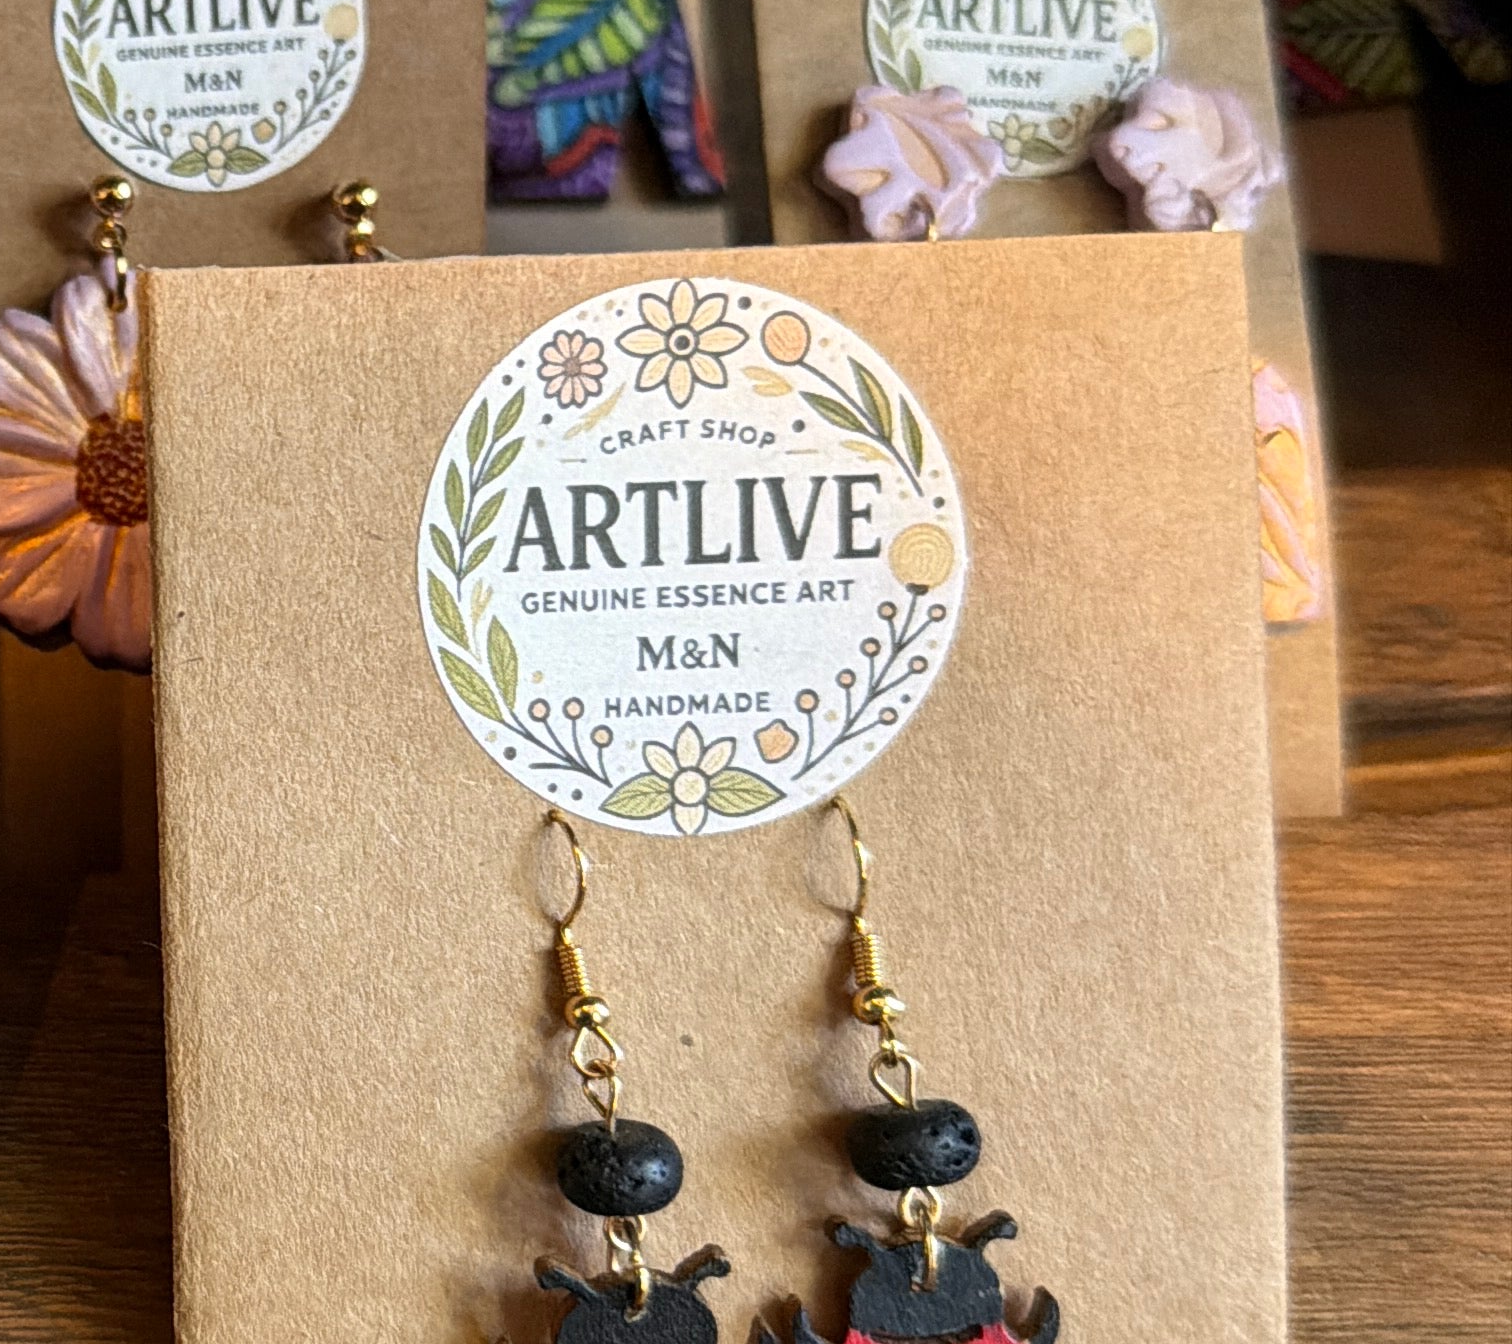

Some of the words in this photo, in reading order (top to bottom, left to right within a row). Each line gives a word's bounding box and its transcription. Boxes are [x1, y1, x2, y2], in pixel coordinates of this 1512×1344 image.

[116, 46, 188, 62] GENUINE
[194, 42, 267, 58] ESSENCE
[272, 37, 306, 53] ART
[184, 70, 243, 94] M&N
[987, 67, 1043, 89] M&N
[166, 103, 260, 120] HANDMADE
[599, 419, 689, 455] CRAFT
[700, 419, 777, 450] SHOP
[502, 473, 882, 573] ARTLIVE
[520, 587, 646, 615] GENUINE
[657, 582, 786, 608] ESSENCE
[795, 579, 855, 602] ART
[636, 633, 740, 672] M&N
[604, 692, 771, 719] HANDMADE
